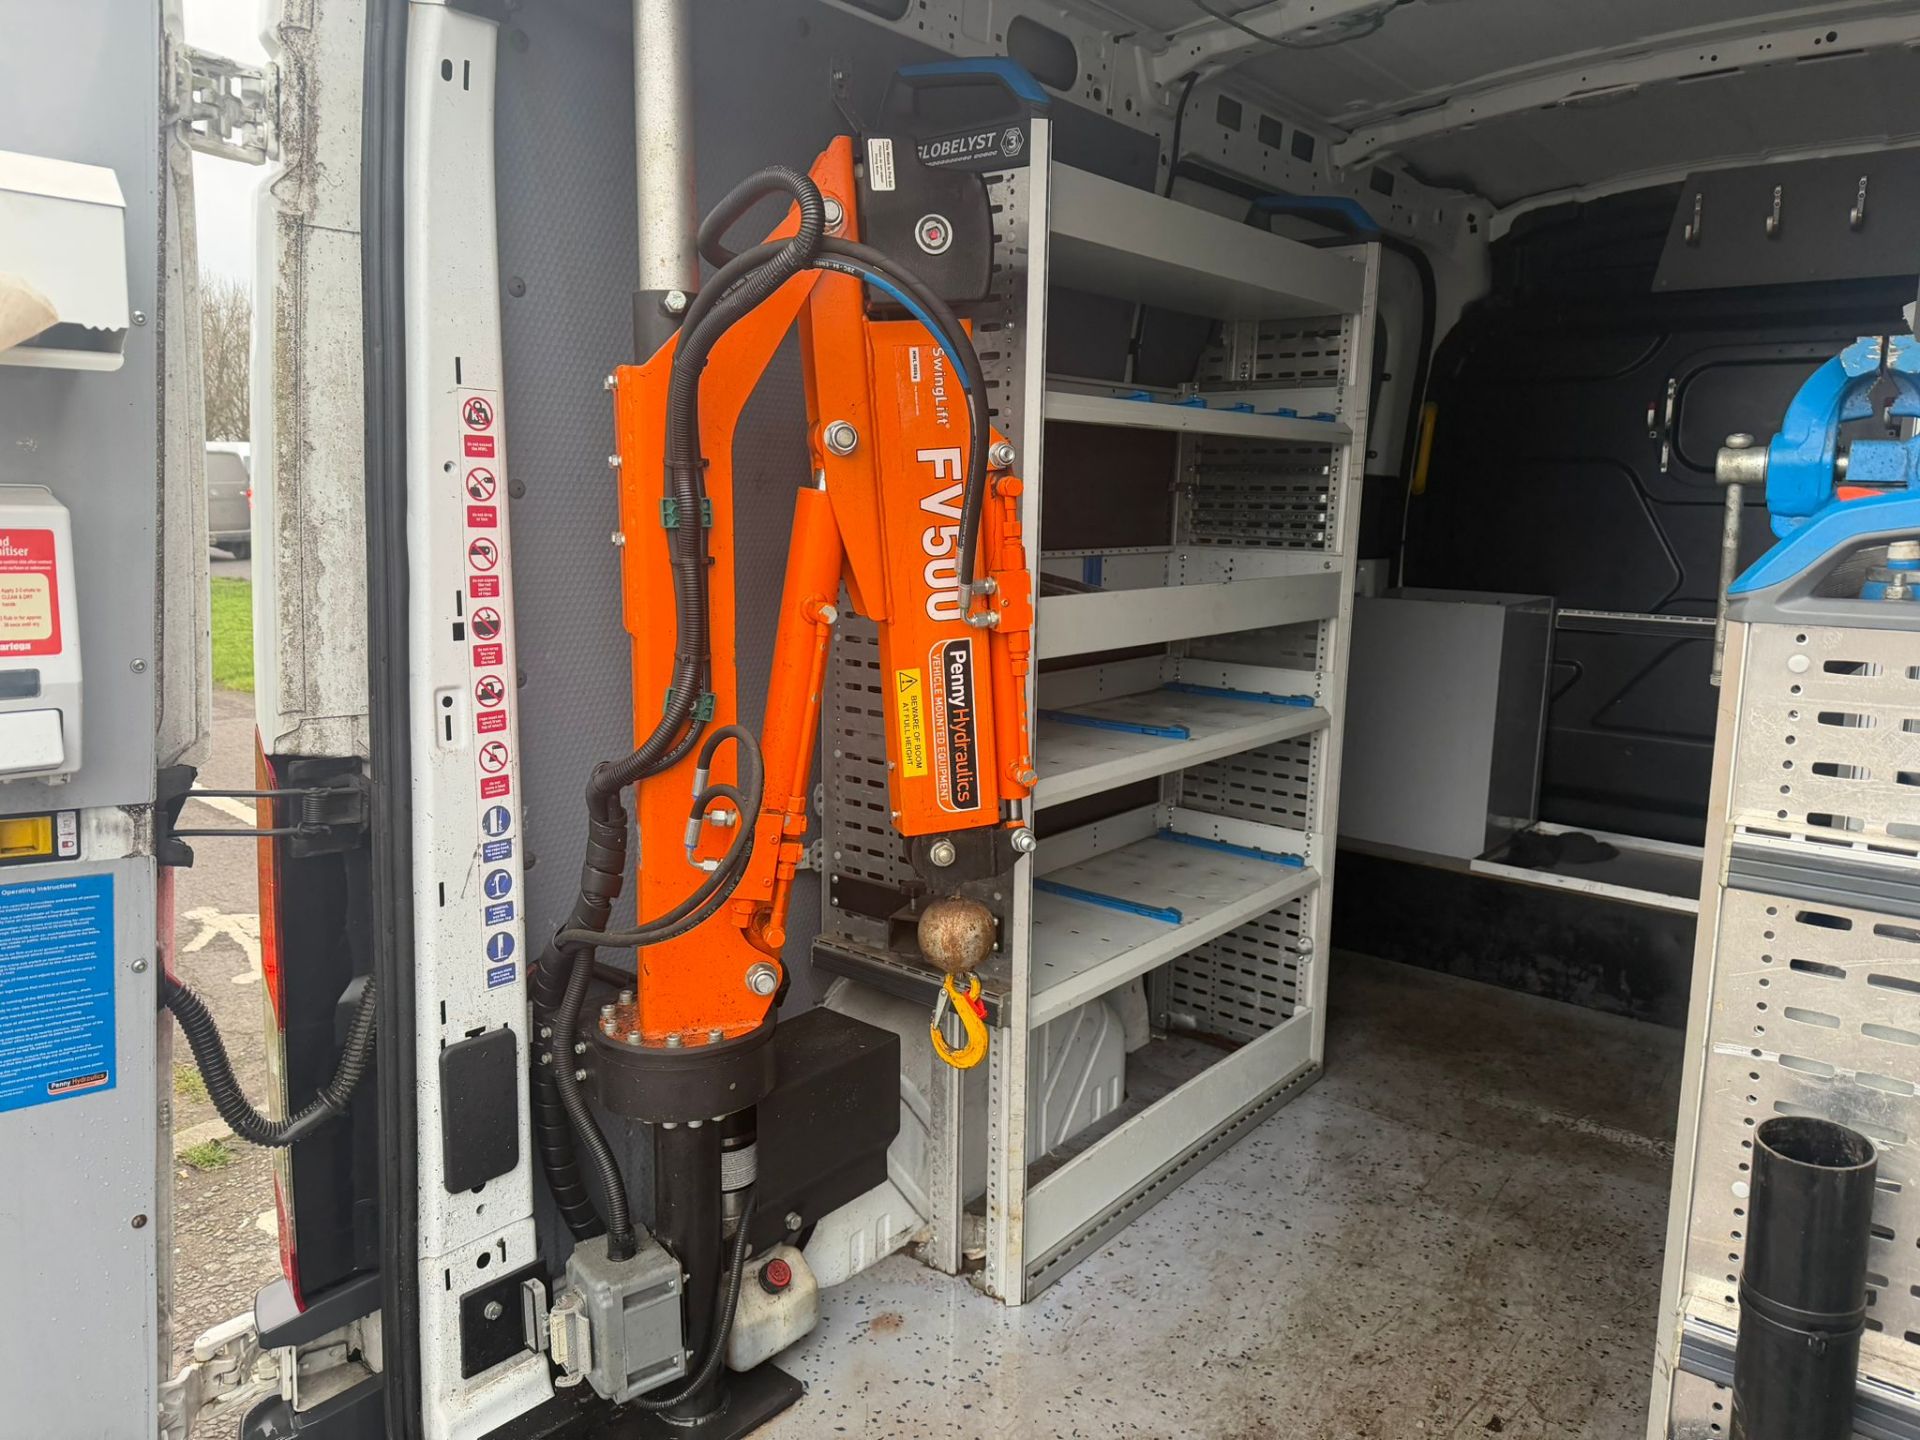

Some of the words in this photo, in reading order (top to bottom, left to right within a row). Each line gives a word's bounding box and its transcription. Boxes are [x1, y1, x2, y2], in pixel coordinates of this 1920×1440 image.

[916, 447, 963, 622] FV500
[931, 654, 943, 694] VEHICLE
[949, 650, 966, 707] Penny
[902, 702, 909, 712] AT
[911, 695, 920, 730] BEWARE
[933, 696, 945, 746] MOUNTED
[903, 714, 911, 735] FULL
[914, 732, 921, 741] OF
[905, 736, 913, 766] HEIGHT
[915, 742, 923, 769] BOOM
[950, 708, 974, 803] Hydraulics
[936, 748, 949, 801] EQUIPMENT
[1, 886, 36, 896] Operating
[37, 883, 77, 892] Instructions
[50, 1079, 71, 1089] Penny
[72, 1073, 105, 1085] Hydraulics
